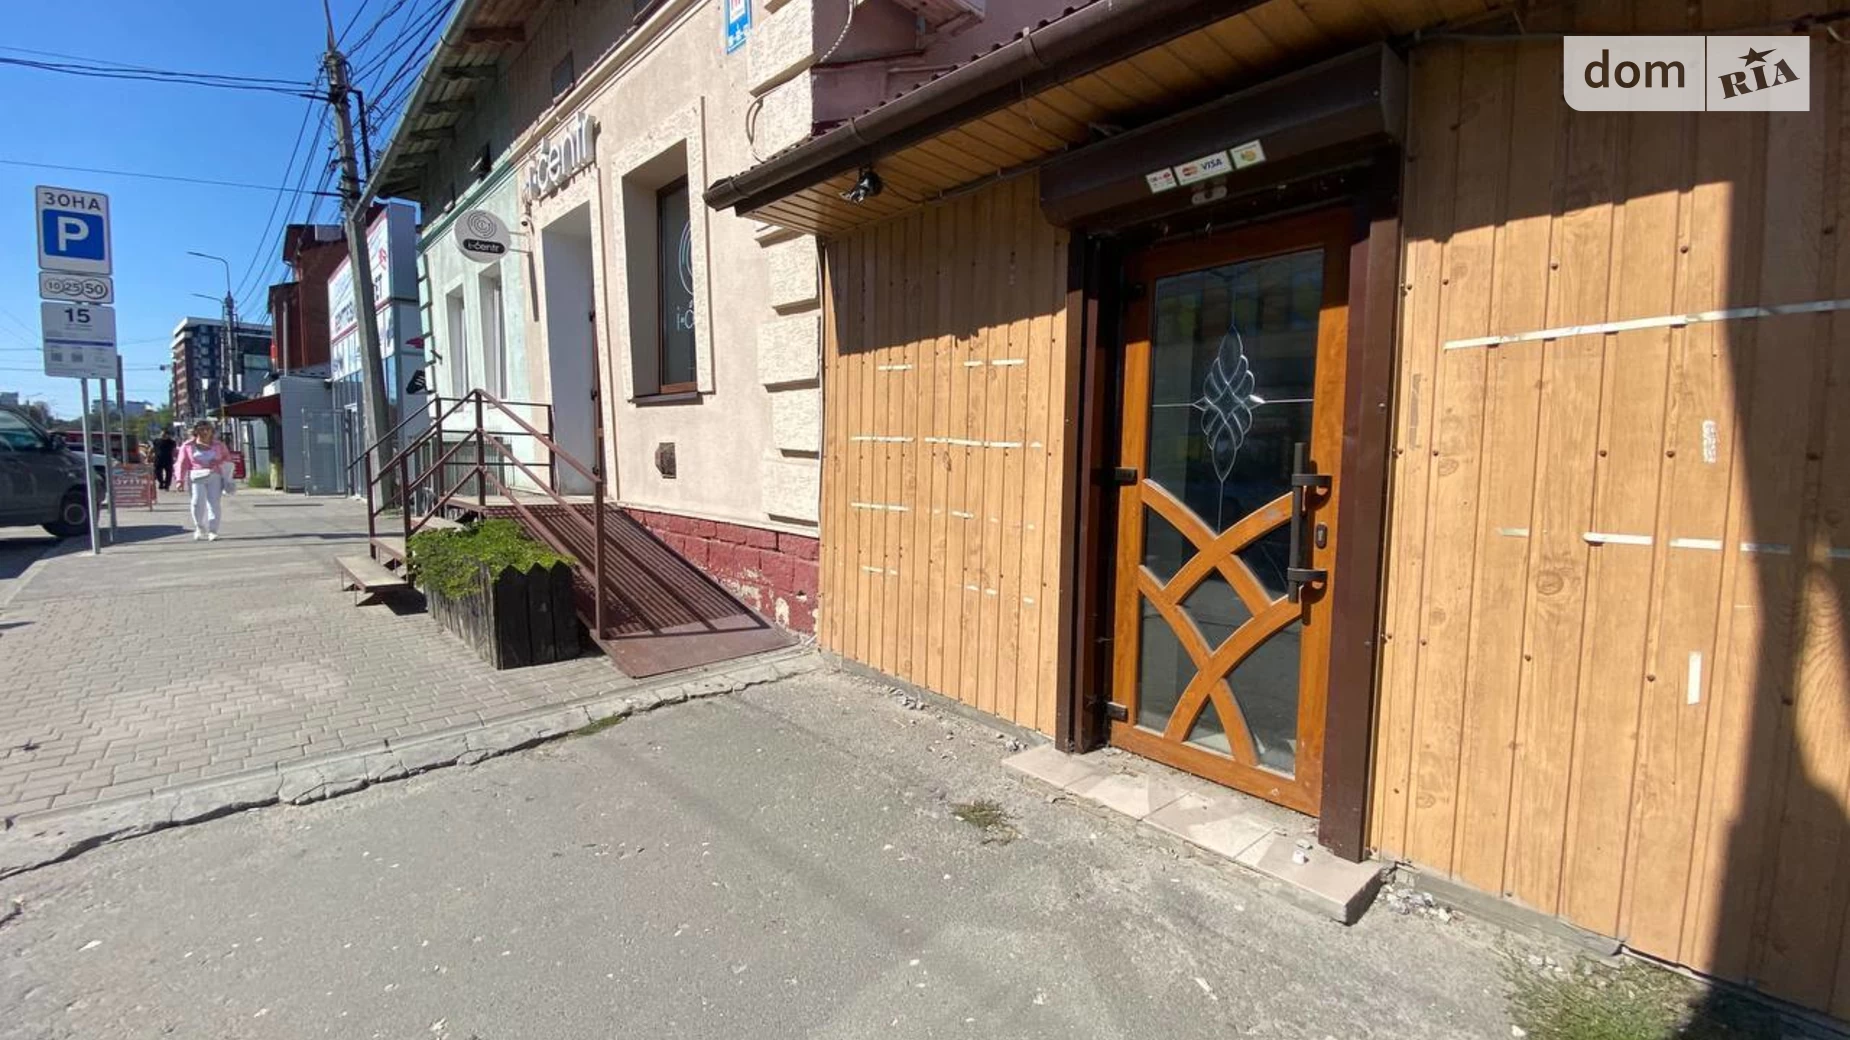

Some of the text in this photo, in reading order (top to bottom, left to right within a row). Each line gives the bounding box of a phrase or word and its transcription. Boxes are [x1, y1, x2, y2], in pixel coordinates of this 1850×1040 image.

[1201, 158, 1223, 170] VISA
[44, 192, 101, 210] ЗОНА
[48, 281, 104, 295] 10 25 50
[64, 308, 91, 323] 15
